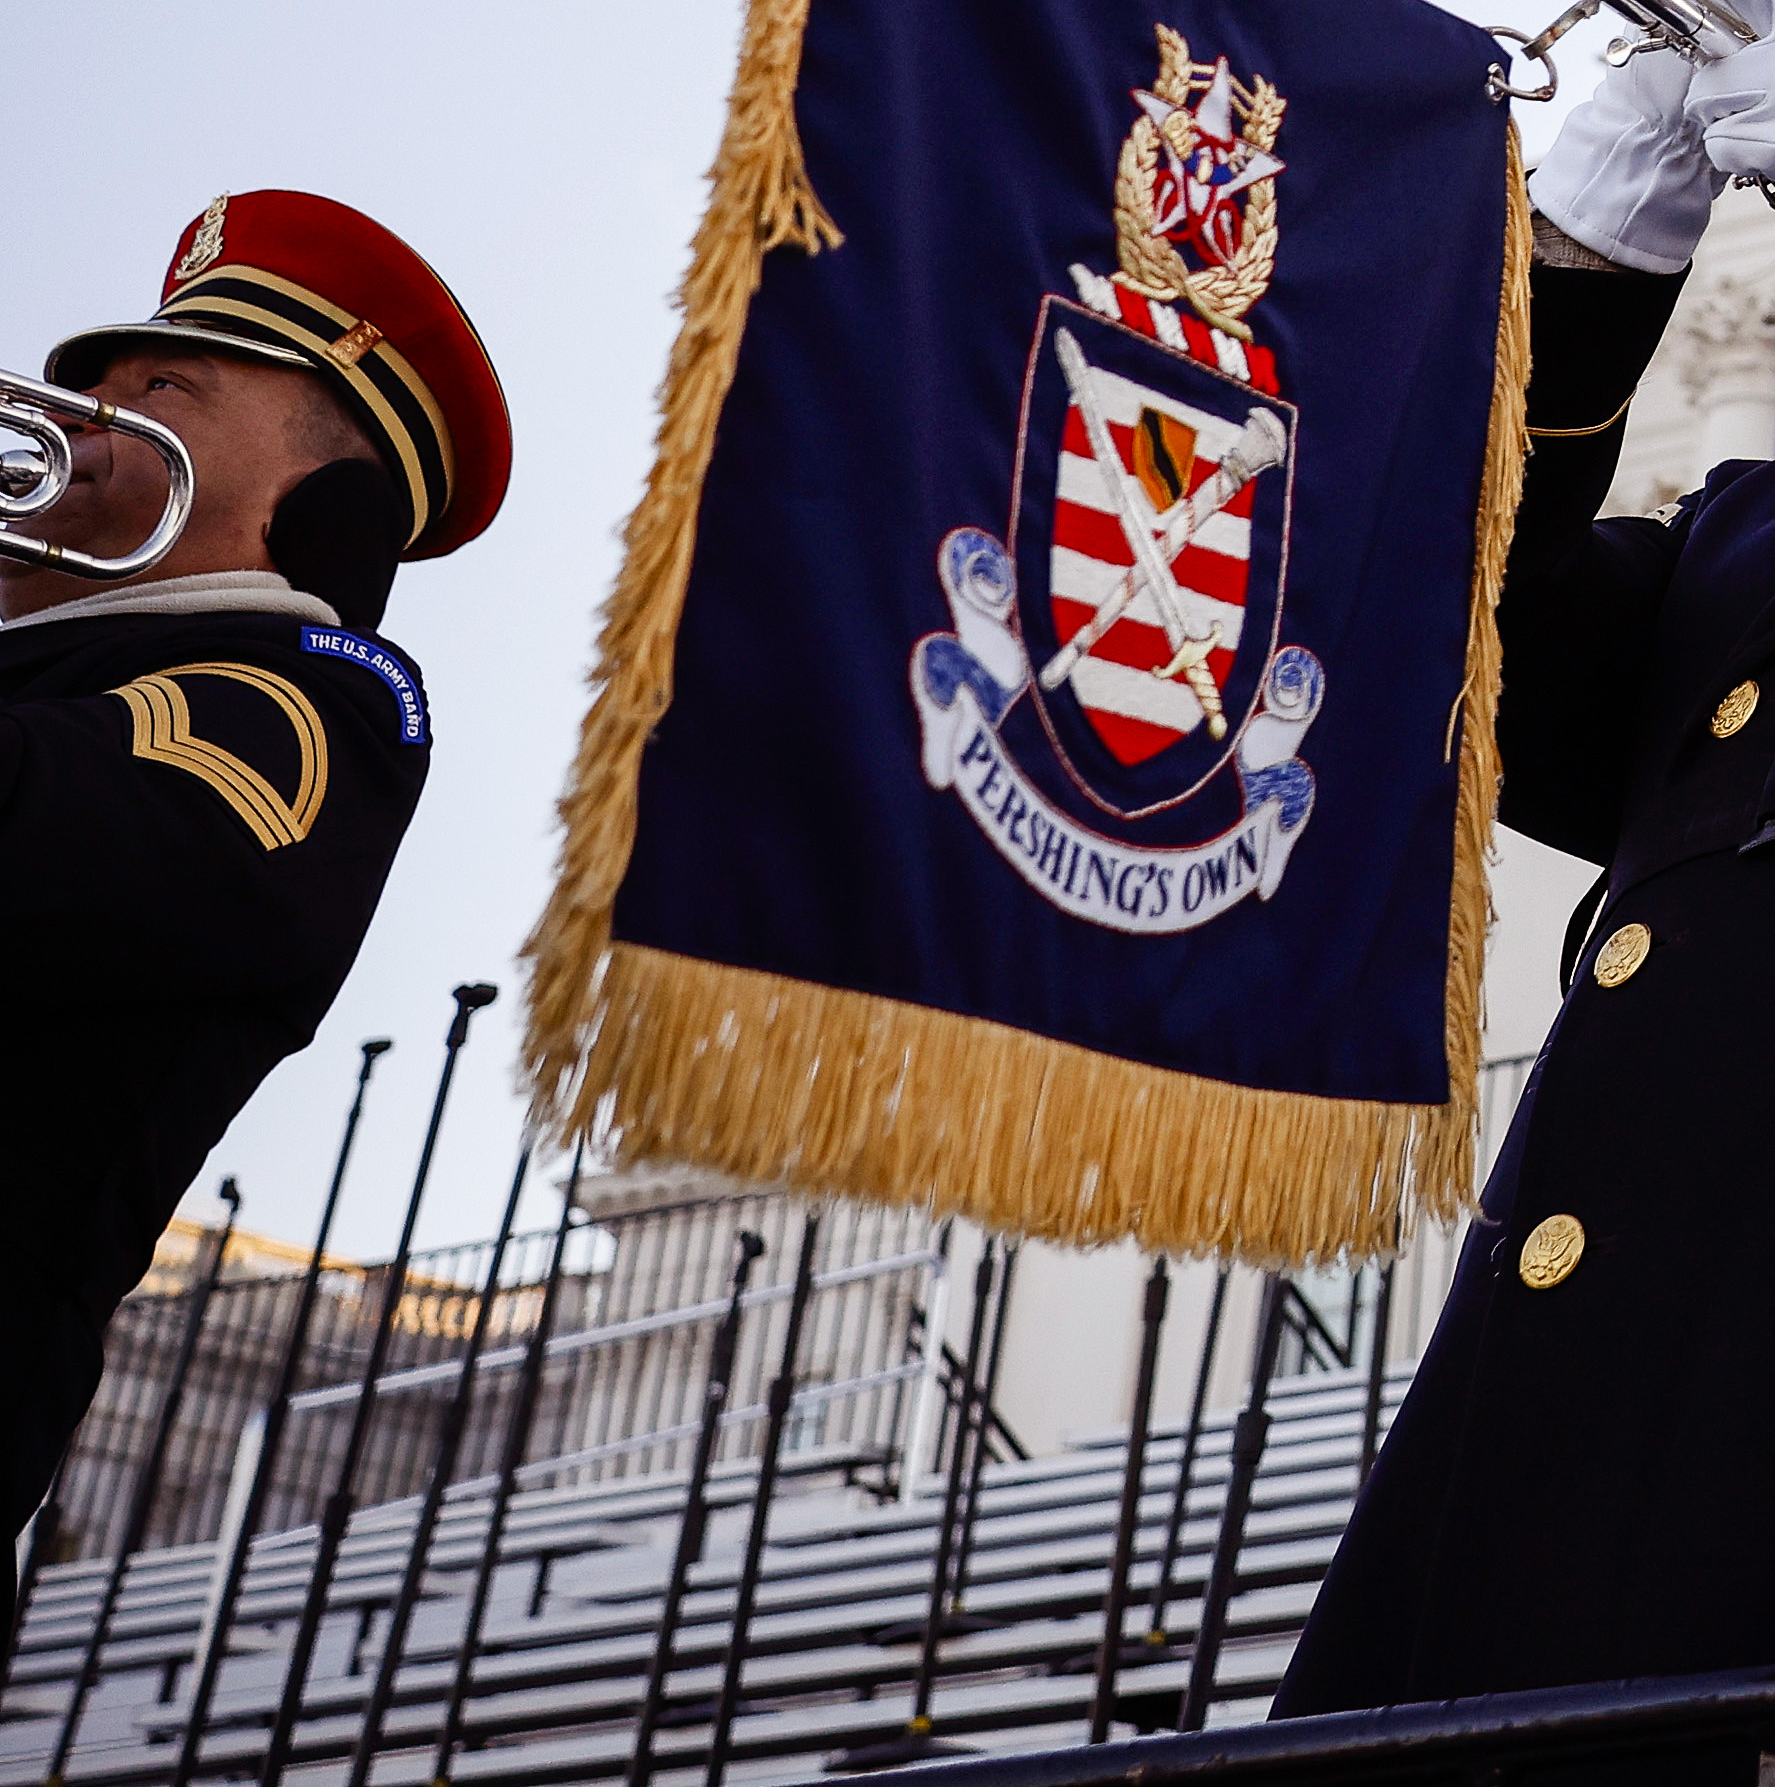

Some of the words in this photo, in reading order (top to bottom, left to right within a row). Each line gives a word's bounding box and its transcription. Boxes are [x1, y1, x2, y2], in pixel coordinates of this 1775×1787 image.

[309, 633, 342, 651] THE
[343, 639, 370, 661] U.S.
[370, 654, 410, 689] ARMY
[402, 691, 419, 737] BAND
[960, 729, 1174, 917] PERSHING'S
[1182, 825, 1257, 912] OWN
